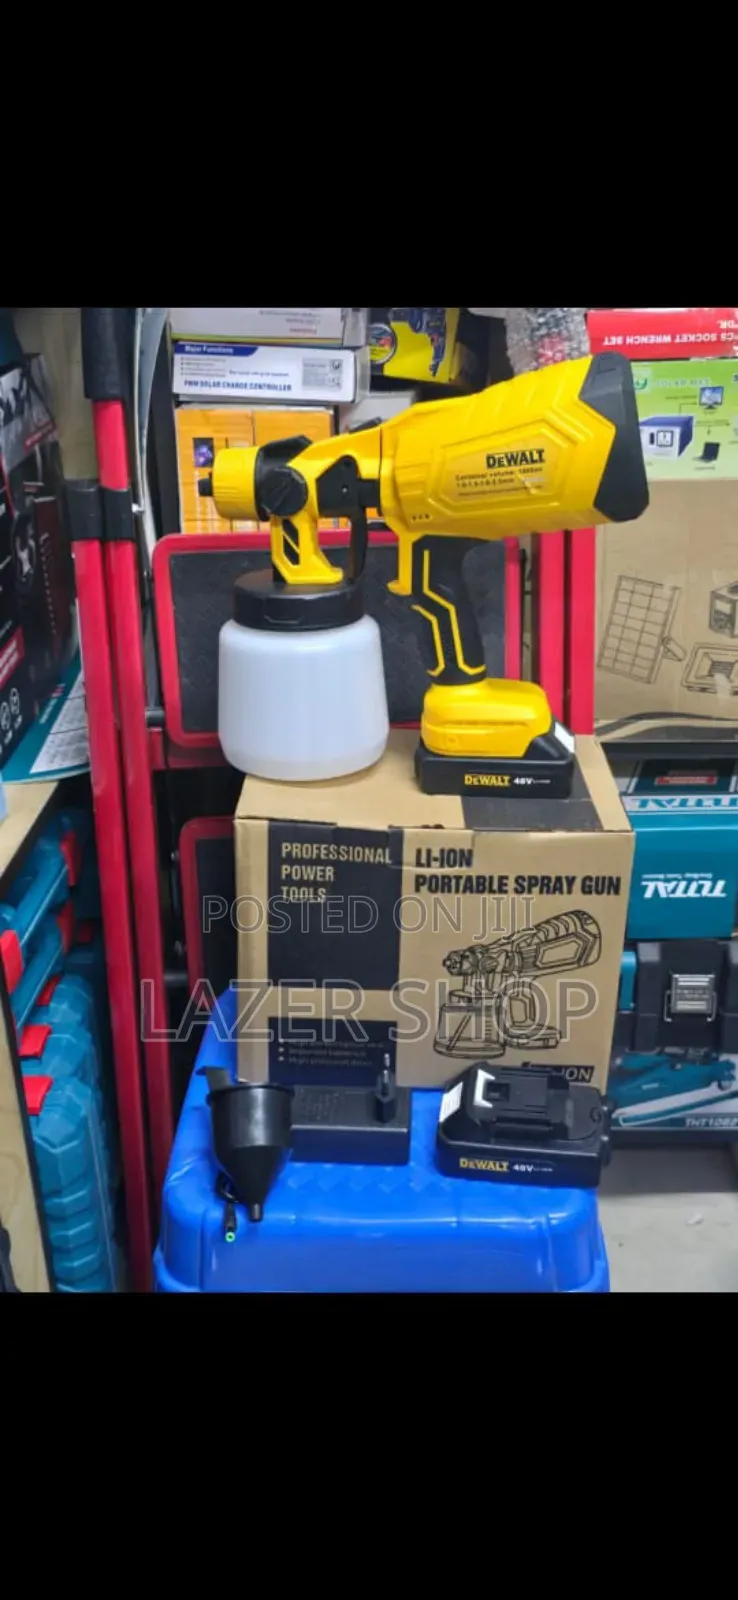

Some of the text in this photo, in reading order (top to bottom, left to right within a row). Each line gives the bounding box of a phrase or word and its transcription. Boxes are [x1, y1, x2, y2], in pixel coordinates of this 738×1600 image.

[603, 336, 623, 345] SET
[625, 334, 672, 345] WRENCH
[674, 333, 717, 343] SOCKET
[200, 380, 221, 388] SOLAR
[222, 381, 248, 389] CHARGE
[249, 382, 292, 391] CONTROLLER
[281, 842, 392, 864] PROFESSIONAL
[415, 848, 474, 869] LI-ION
[281, 864, 335, 882] POWER
[414, 873, 621, 896] PORTABLE SPRAY GUN
[641, 880, 727, 898] TOTAL
[281, 885, 327, 903] TOOLS
